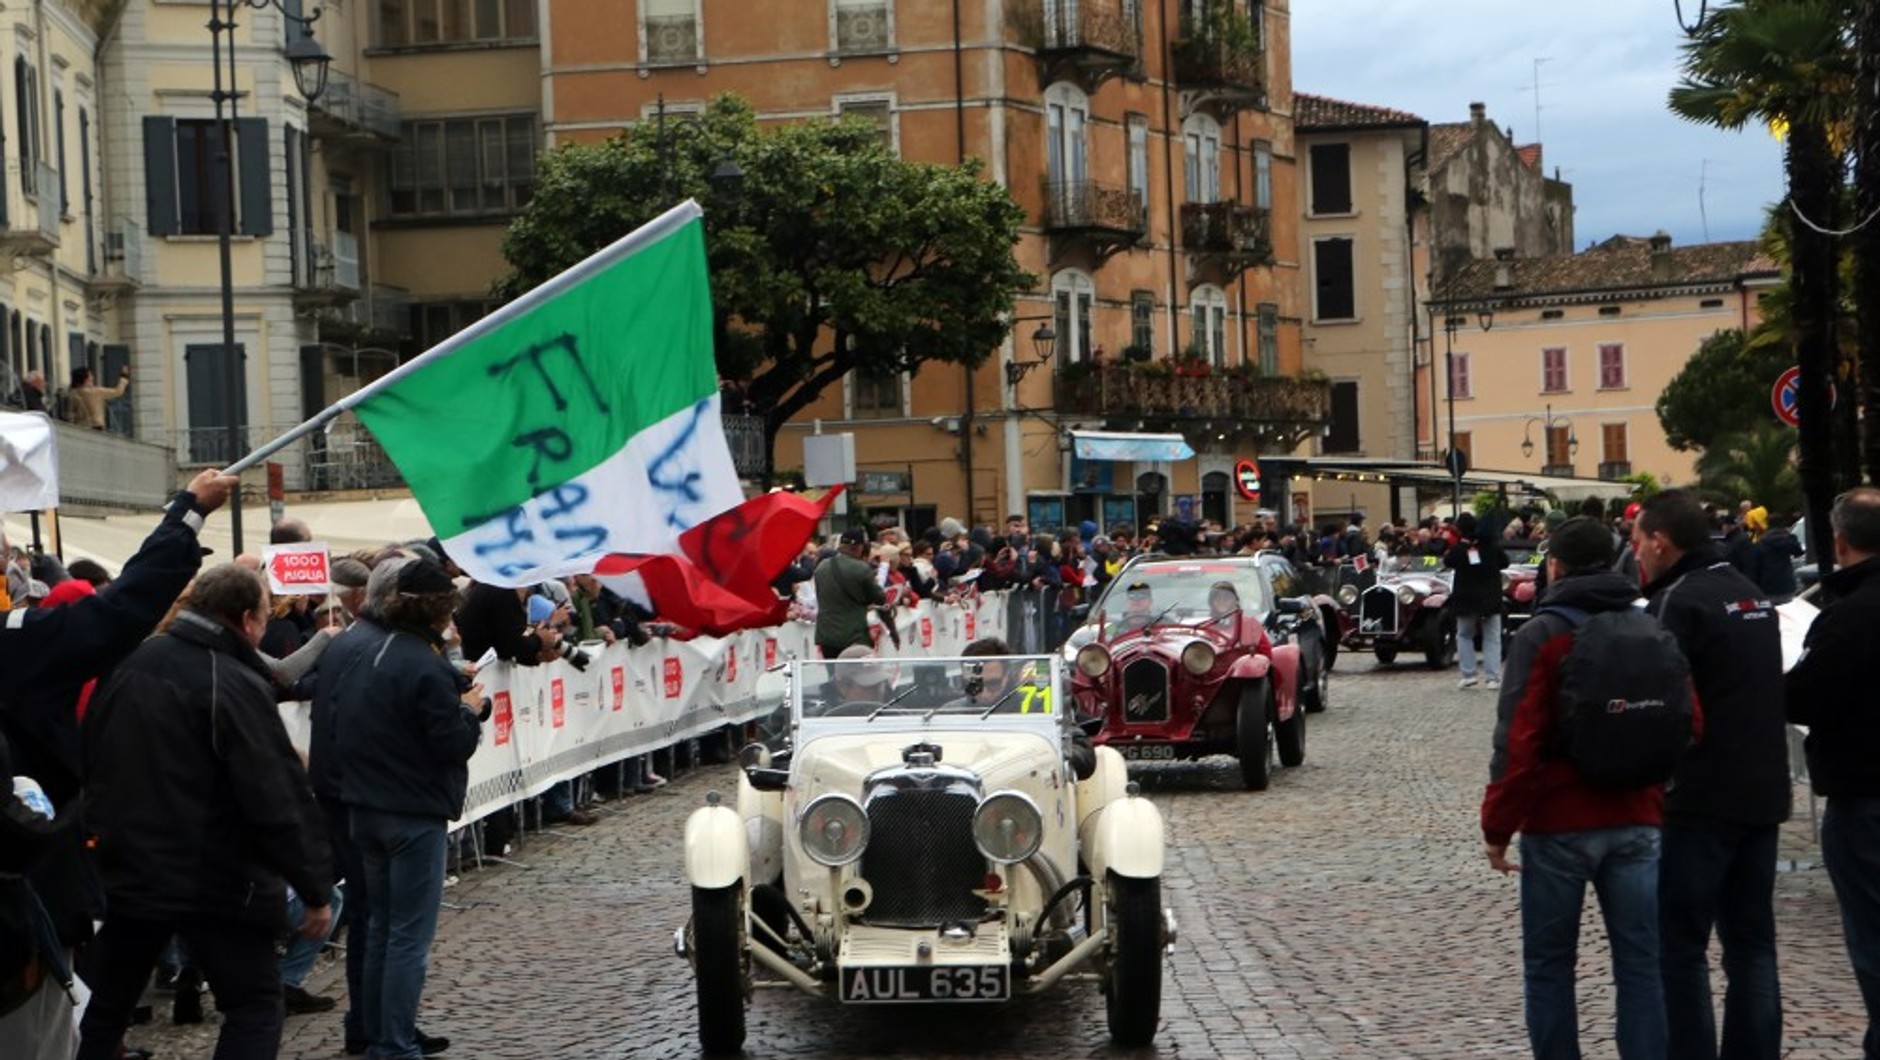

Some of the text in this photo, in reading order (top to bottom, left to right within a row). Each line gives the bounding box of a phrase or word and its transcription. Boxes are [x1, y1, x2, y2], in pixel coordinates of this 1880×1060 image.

[283, 554, 320, 568] 1000
[1017, 684, 1052, 714] 71
[1140, 745, 1175, 759] 690
[850, 967, 1000, 999] AUL 635
